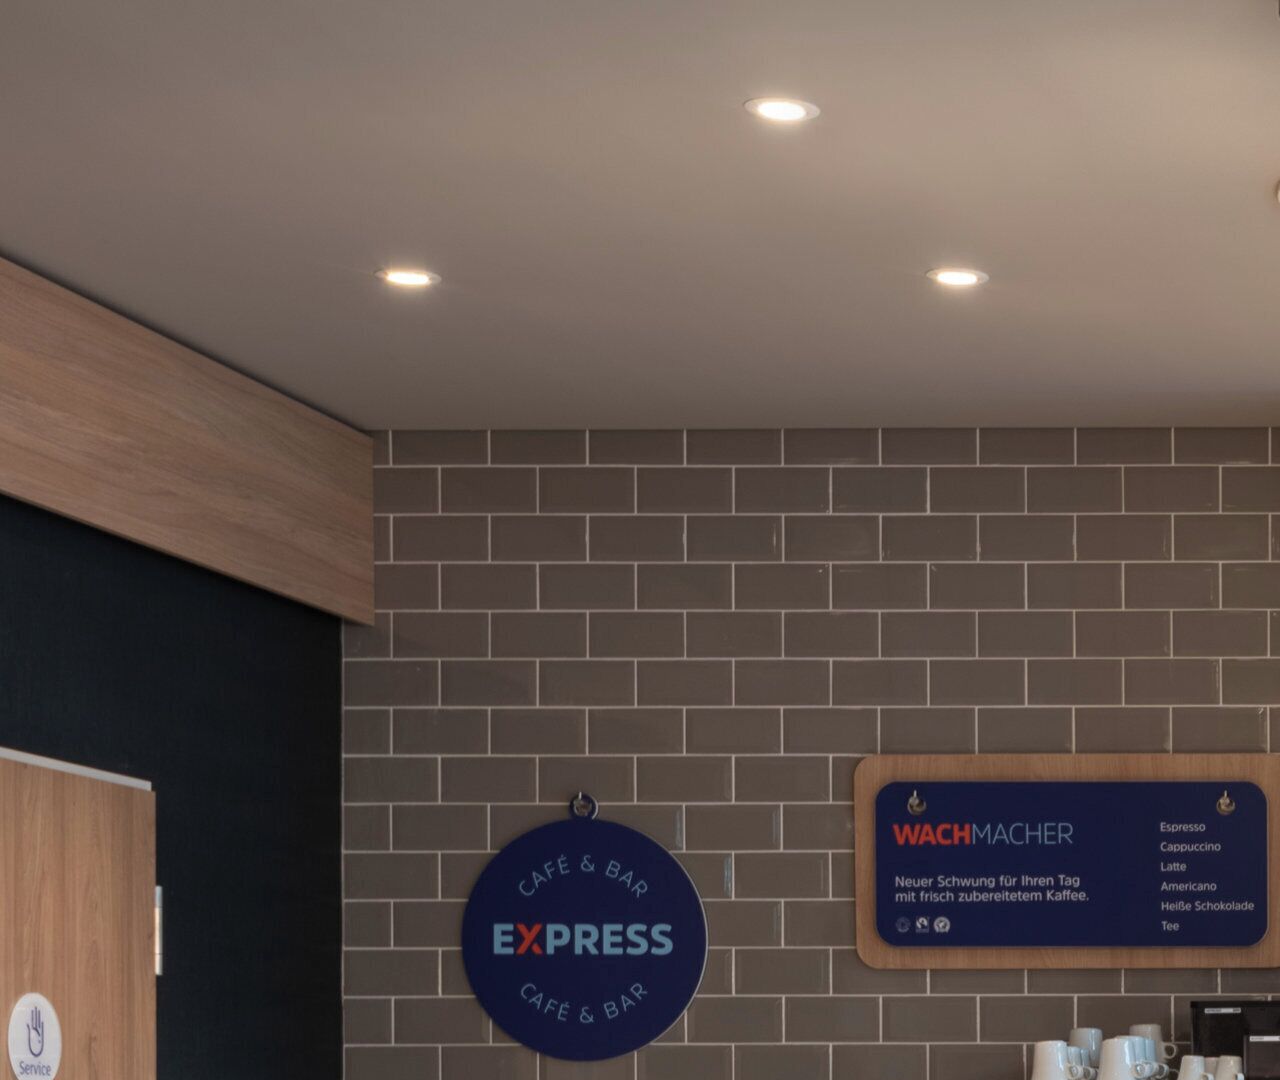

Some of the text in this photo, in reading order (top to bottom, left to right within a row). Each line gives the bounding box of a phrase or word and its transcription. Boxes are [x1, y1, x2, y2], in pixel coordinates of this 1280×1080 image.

[893, 822, 1074, 845] WACHMACHER
[1160, 822, 1206, 833] Espresso
[1160, 841, 1222, 853] Cappuccino
[1160, 861, 1187, 872] Latte
[518, 854, 648, 898] CAFÉ & BAR
[895, 874, 1081, 889] Neuer Schwung für Ihren Tag
[1160, 881, 1217, 891] Americano
[895, 889, 1090, 903] mit frisch zubereitetem Kaffee.
[1161, 900, 1255, 911] Heiße Schokolade
[1161, 920, 1180, 931] Tee
[493, 922, 674, 956] EXPRESS
[520, 982, 648, 1023] CAFÉ & BAR
[20, 1060, 52, 1076] Service
